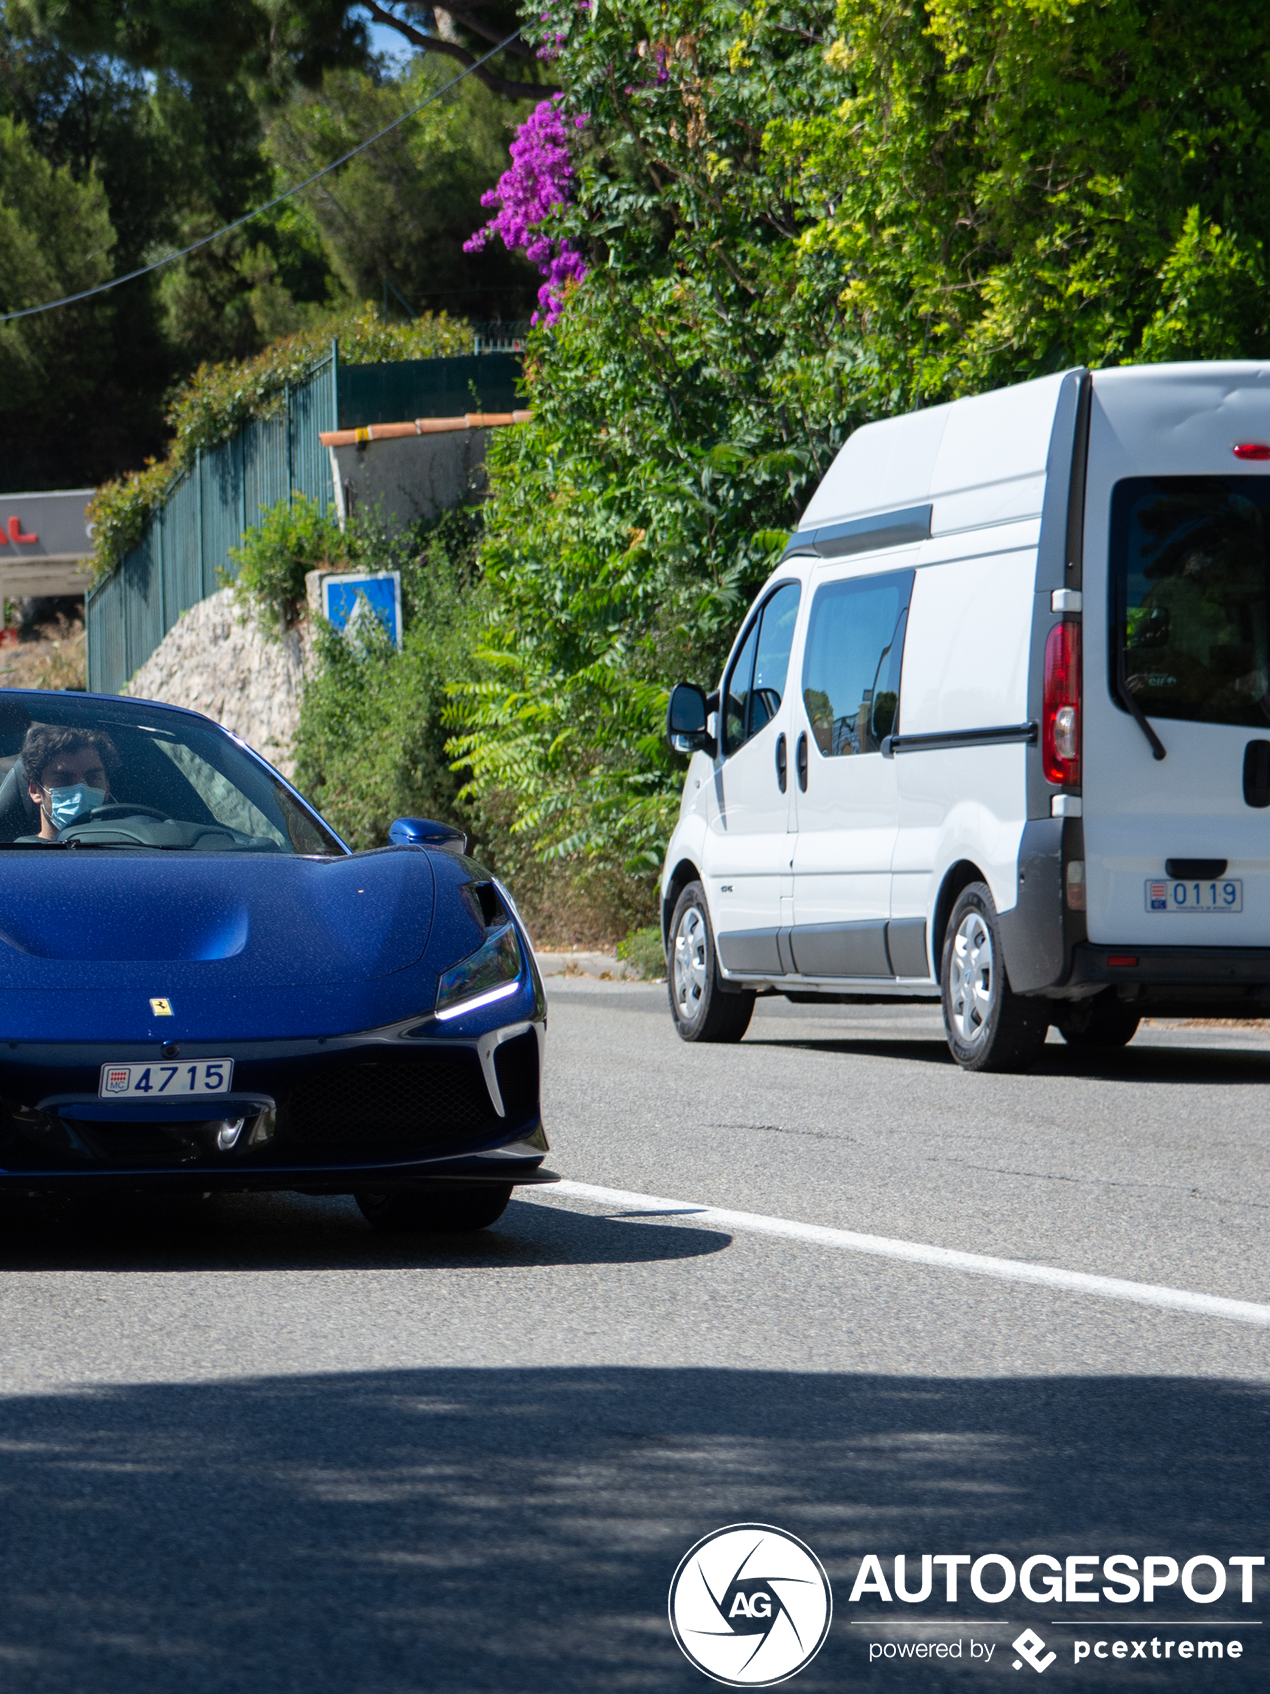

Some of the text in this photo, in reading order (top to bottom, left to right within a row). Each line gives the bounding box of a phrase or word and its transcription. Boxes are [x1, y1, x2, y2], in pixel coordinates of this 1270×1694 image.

[1173, 883, 1236, 905] 0119
[110, 1081, 125, 1089] MC
[134, 1064, 224, 1092] 4715
